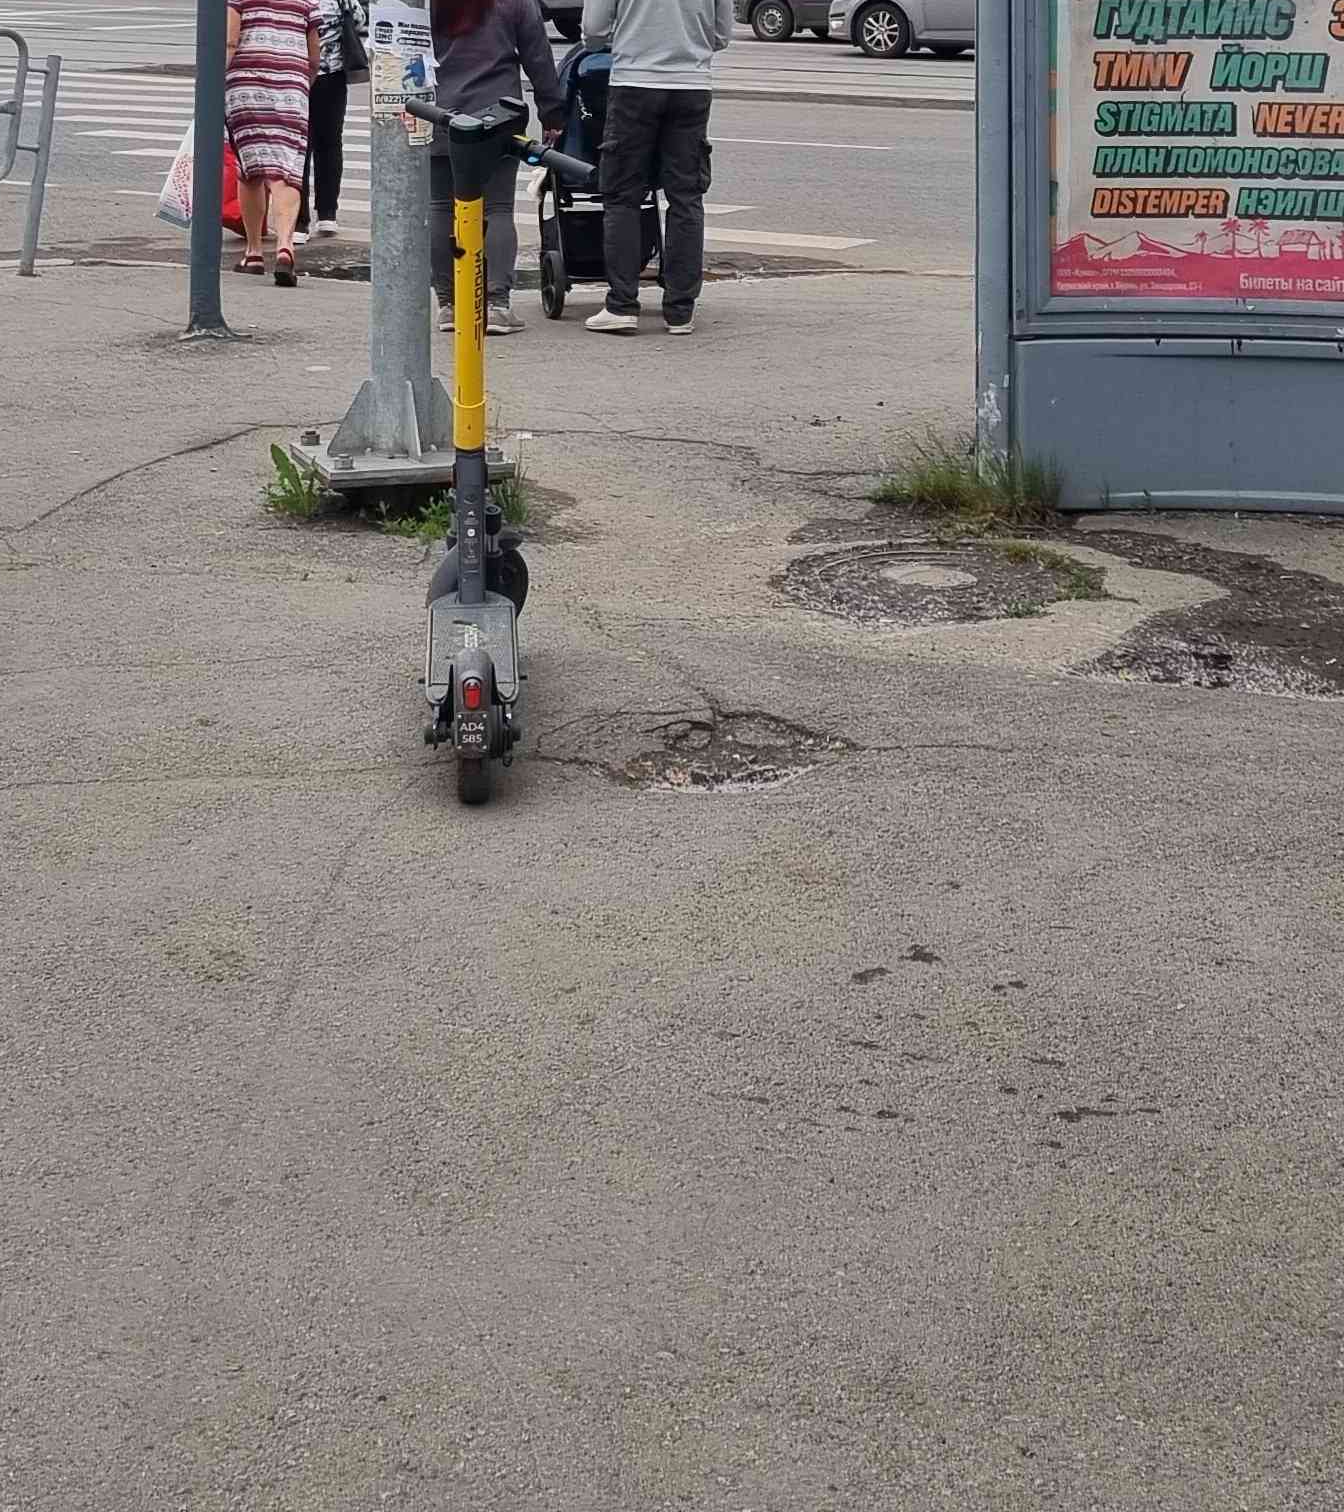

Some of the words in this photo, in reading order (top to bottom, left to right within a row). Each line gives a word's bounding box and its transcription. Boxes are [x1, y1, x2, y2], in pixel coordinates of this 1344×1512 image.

[1093, 51, 1194, 91] TMNV
[1210, 44, 1330, 92] ЙОРШ
[1094, 101, 1237, 137] STIGMATA
[1092, 146, 1168, 178] ПЛАН
[1091, 188, 1230, 218] DISTEMPER
[1235, 187, 1314, 221] НЭИЛ
[1239, 273, 1293, 292] Билеты
[1296, 279, 1312, 292] на
